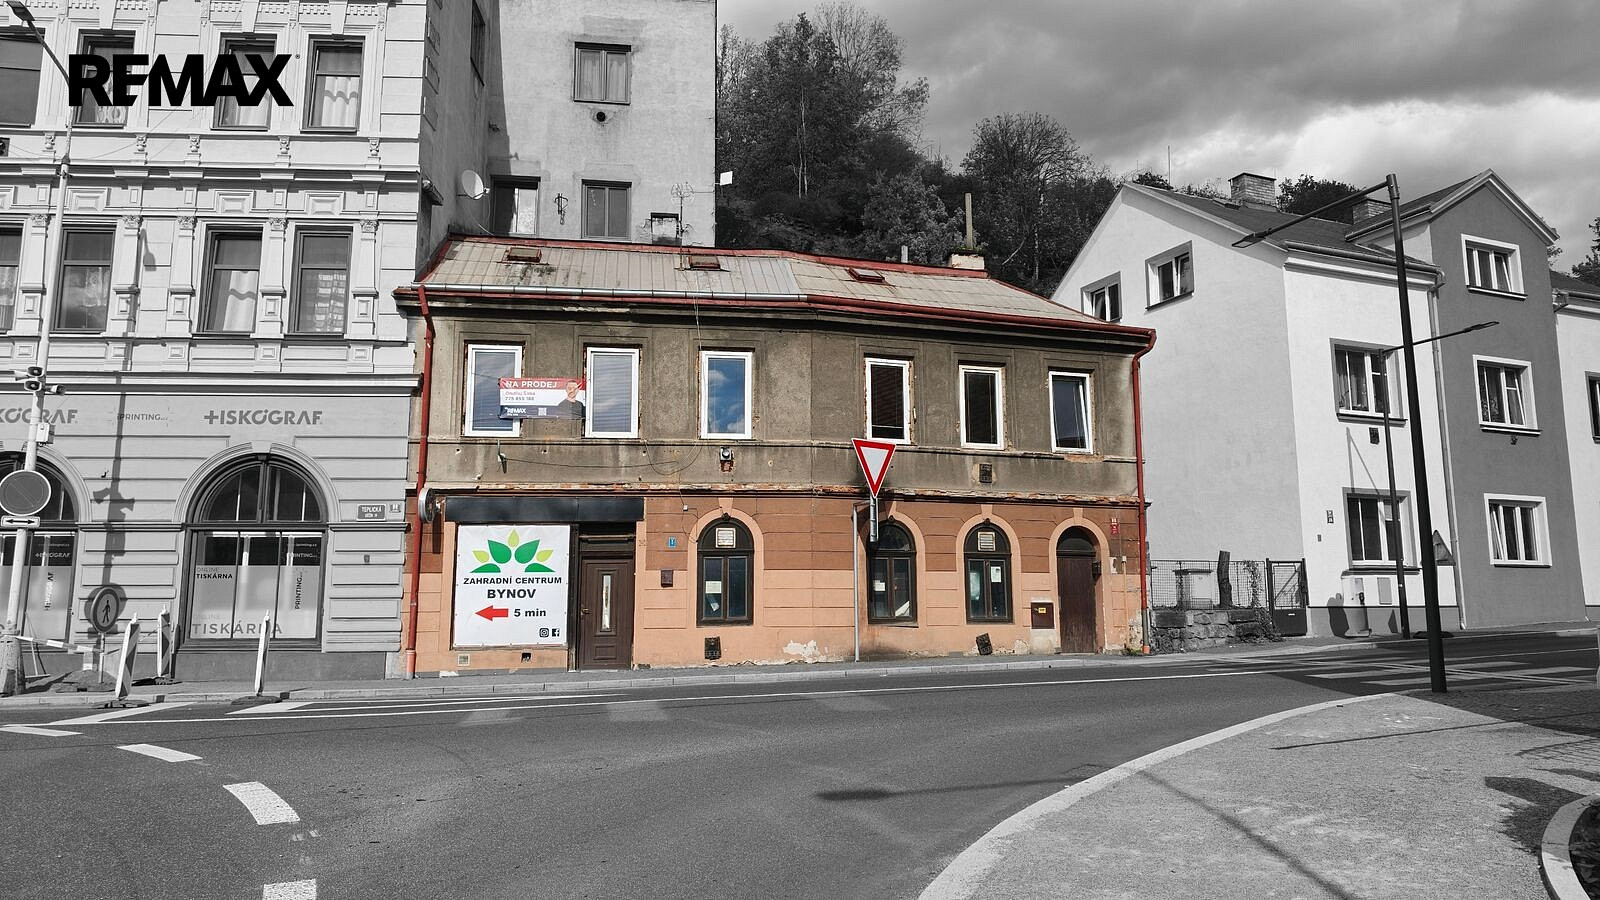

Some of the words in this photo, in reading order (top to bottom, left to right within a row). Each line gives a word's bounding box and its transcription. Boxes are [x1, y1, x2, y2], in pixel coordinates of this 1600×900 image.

[463, 575, 512, 584] ZAHRADNÍ
[487, 588, 537, 599] BYNOV
[514, 608, 521, 617] 5
[524, 608, 547, 617] min
